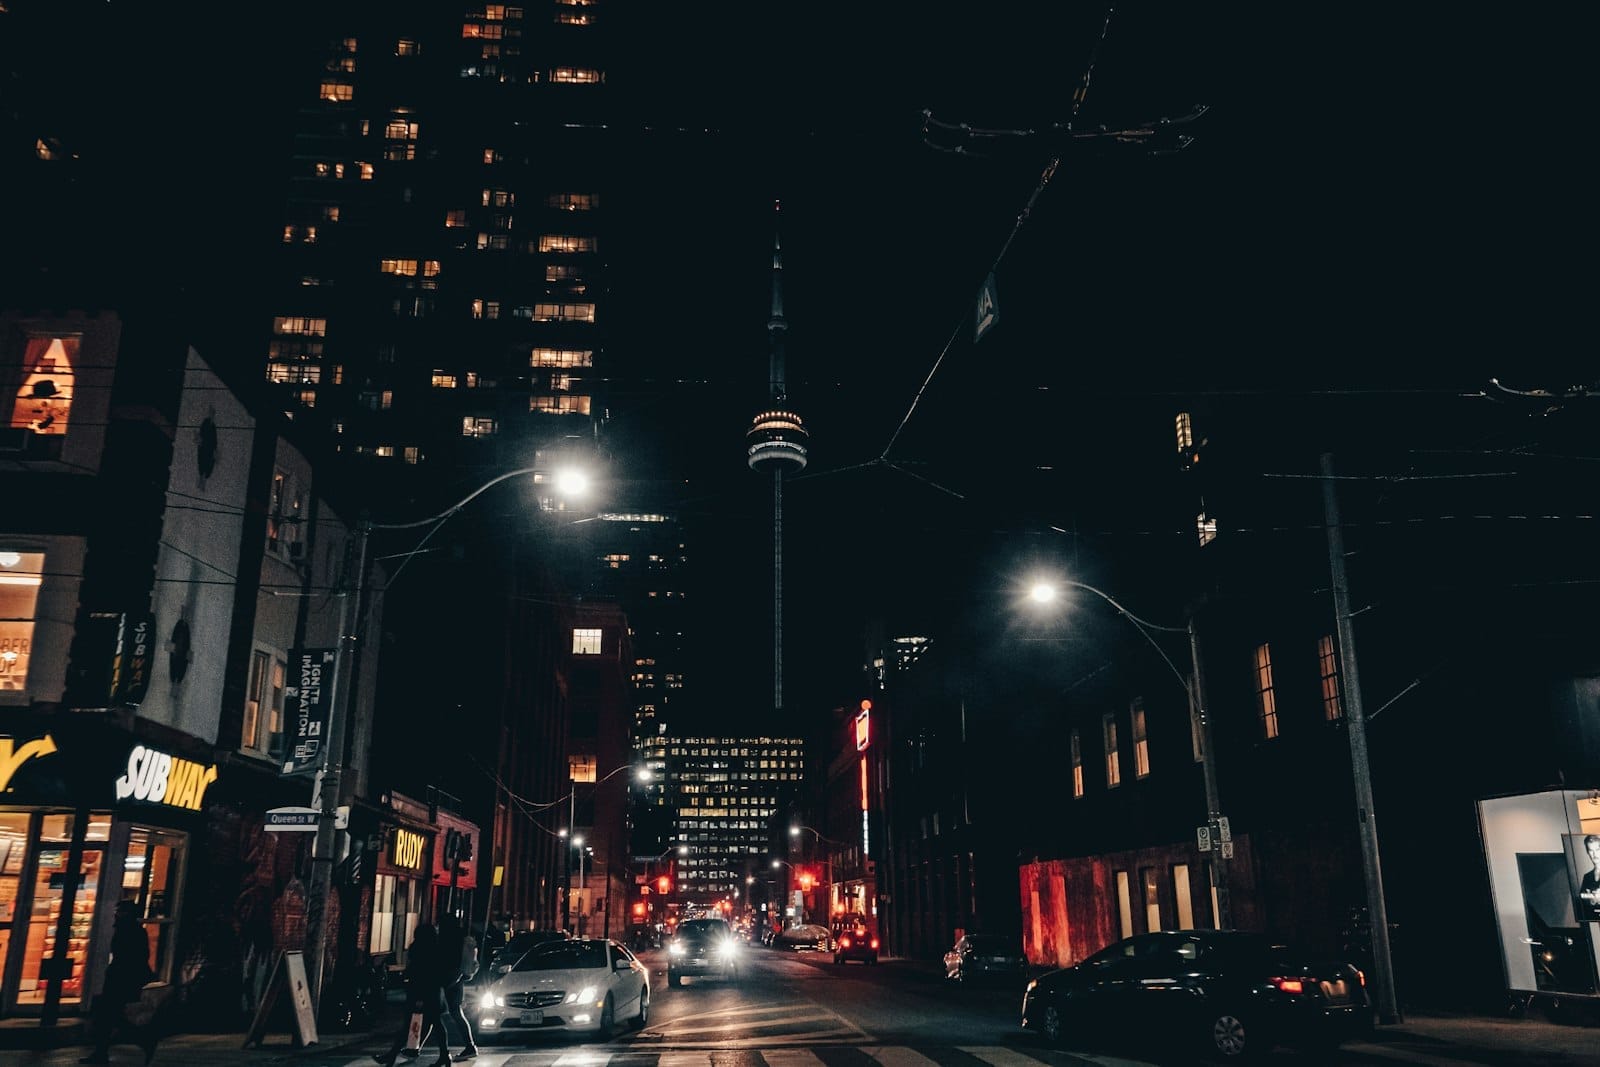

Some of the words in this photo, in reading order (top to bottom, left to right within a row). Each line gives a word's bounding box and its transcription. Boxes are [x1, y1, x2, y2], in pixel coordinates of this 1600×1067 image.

[298, 655, 312, 737] IMAGINATION
[311, 664, 321, 704] IGNITE
[116, 746, 218, 811] SUBWAY
[271, 814, 297, 824] Queen
[307, 815, 315, 823] W
[395, 829, 424, 871] RUDY
